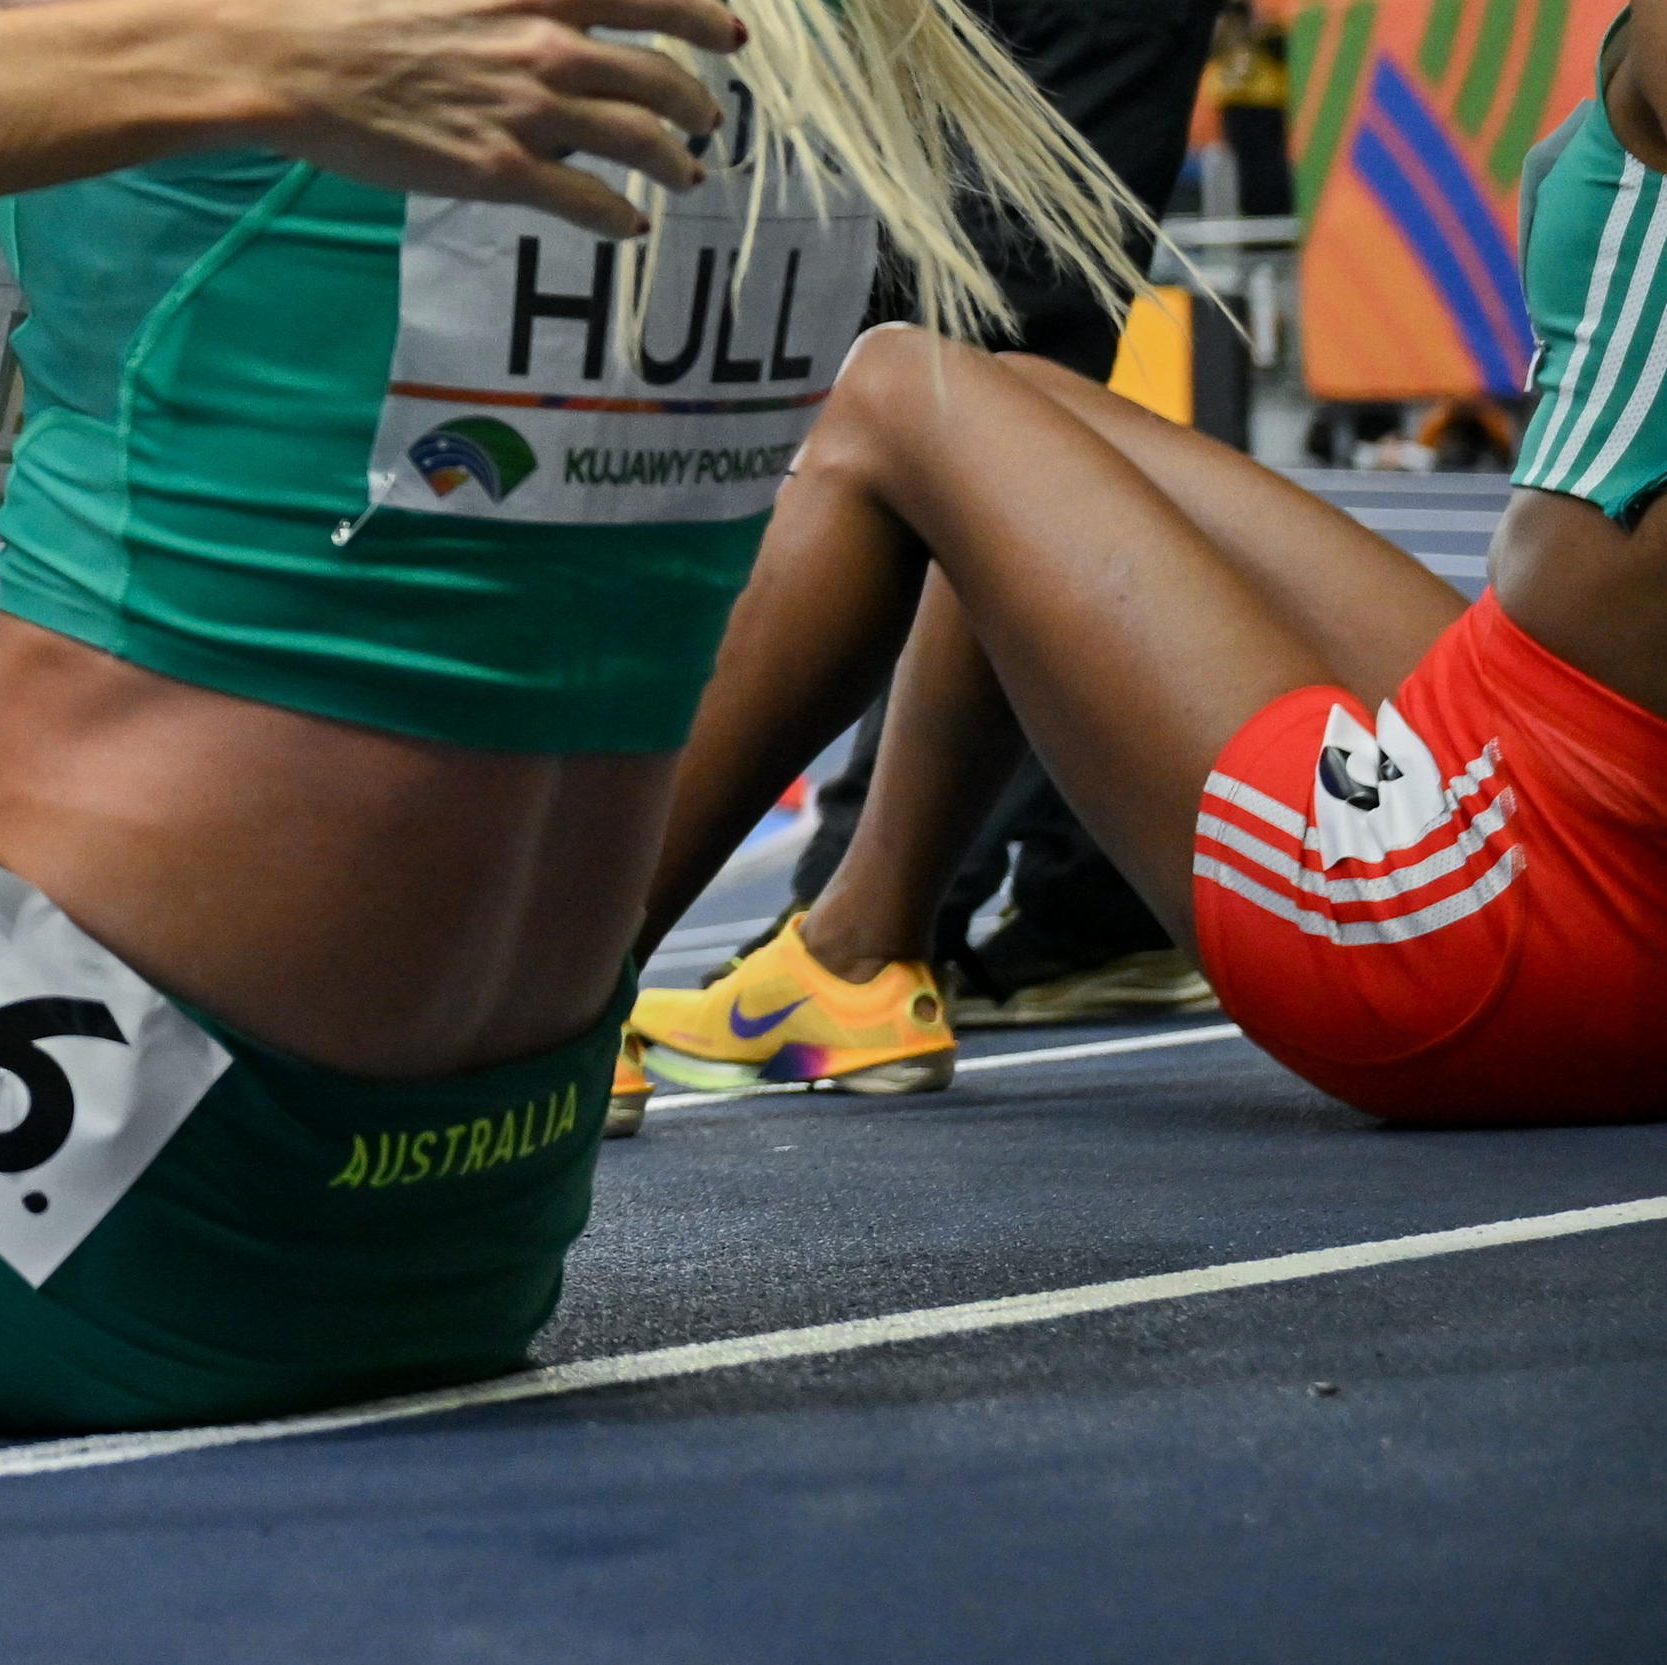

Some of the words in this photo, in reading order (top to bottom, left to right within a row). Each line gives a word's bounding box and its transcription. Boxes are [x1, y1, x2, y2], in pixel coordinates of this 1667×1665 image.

[508, 235, 813, 385] HULL
[564, 447, 696, 485] KUJAWY
[328, 1081, 577, 1188] AUSTRALIA
